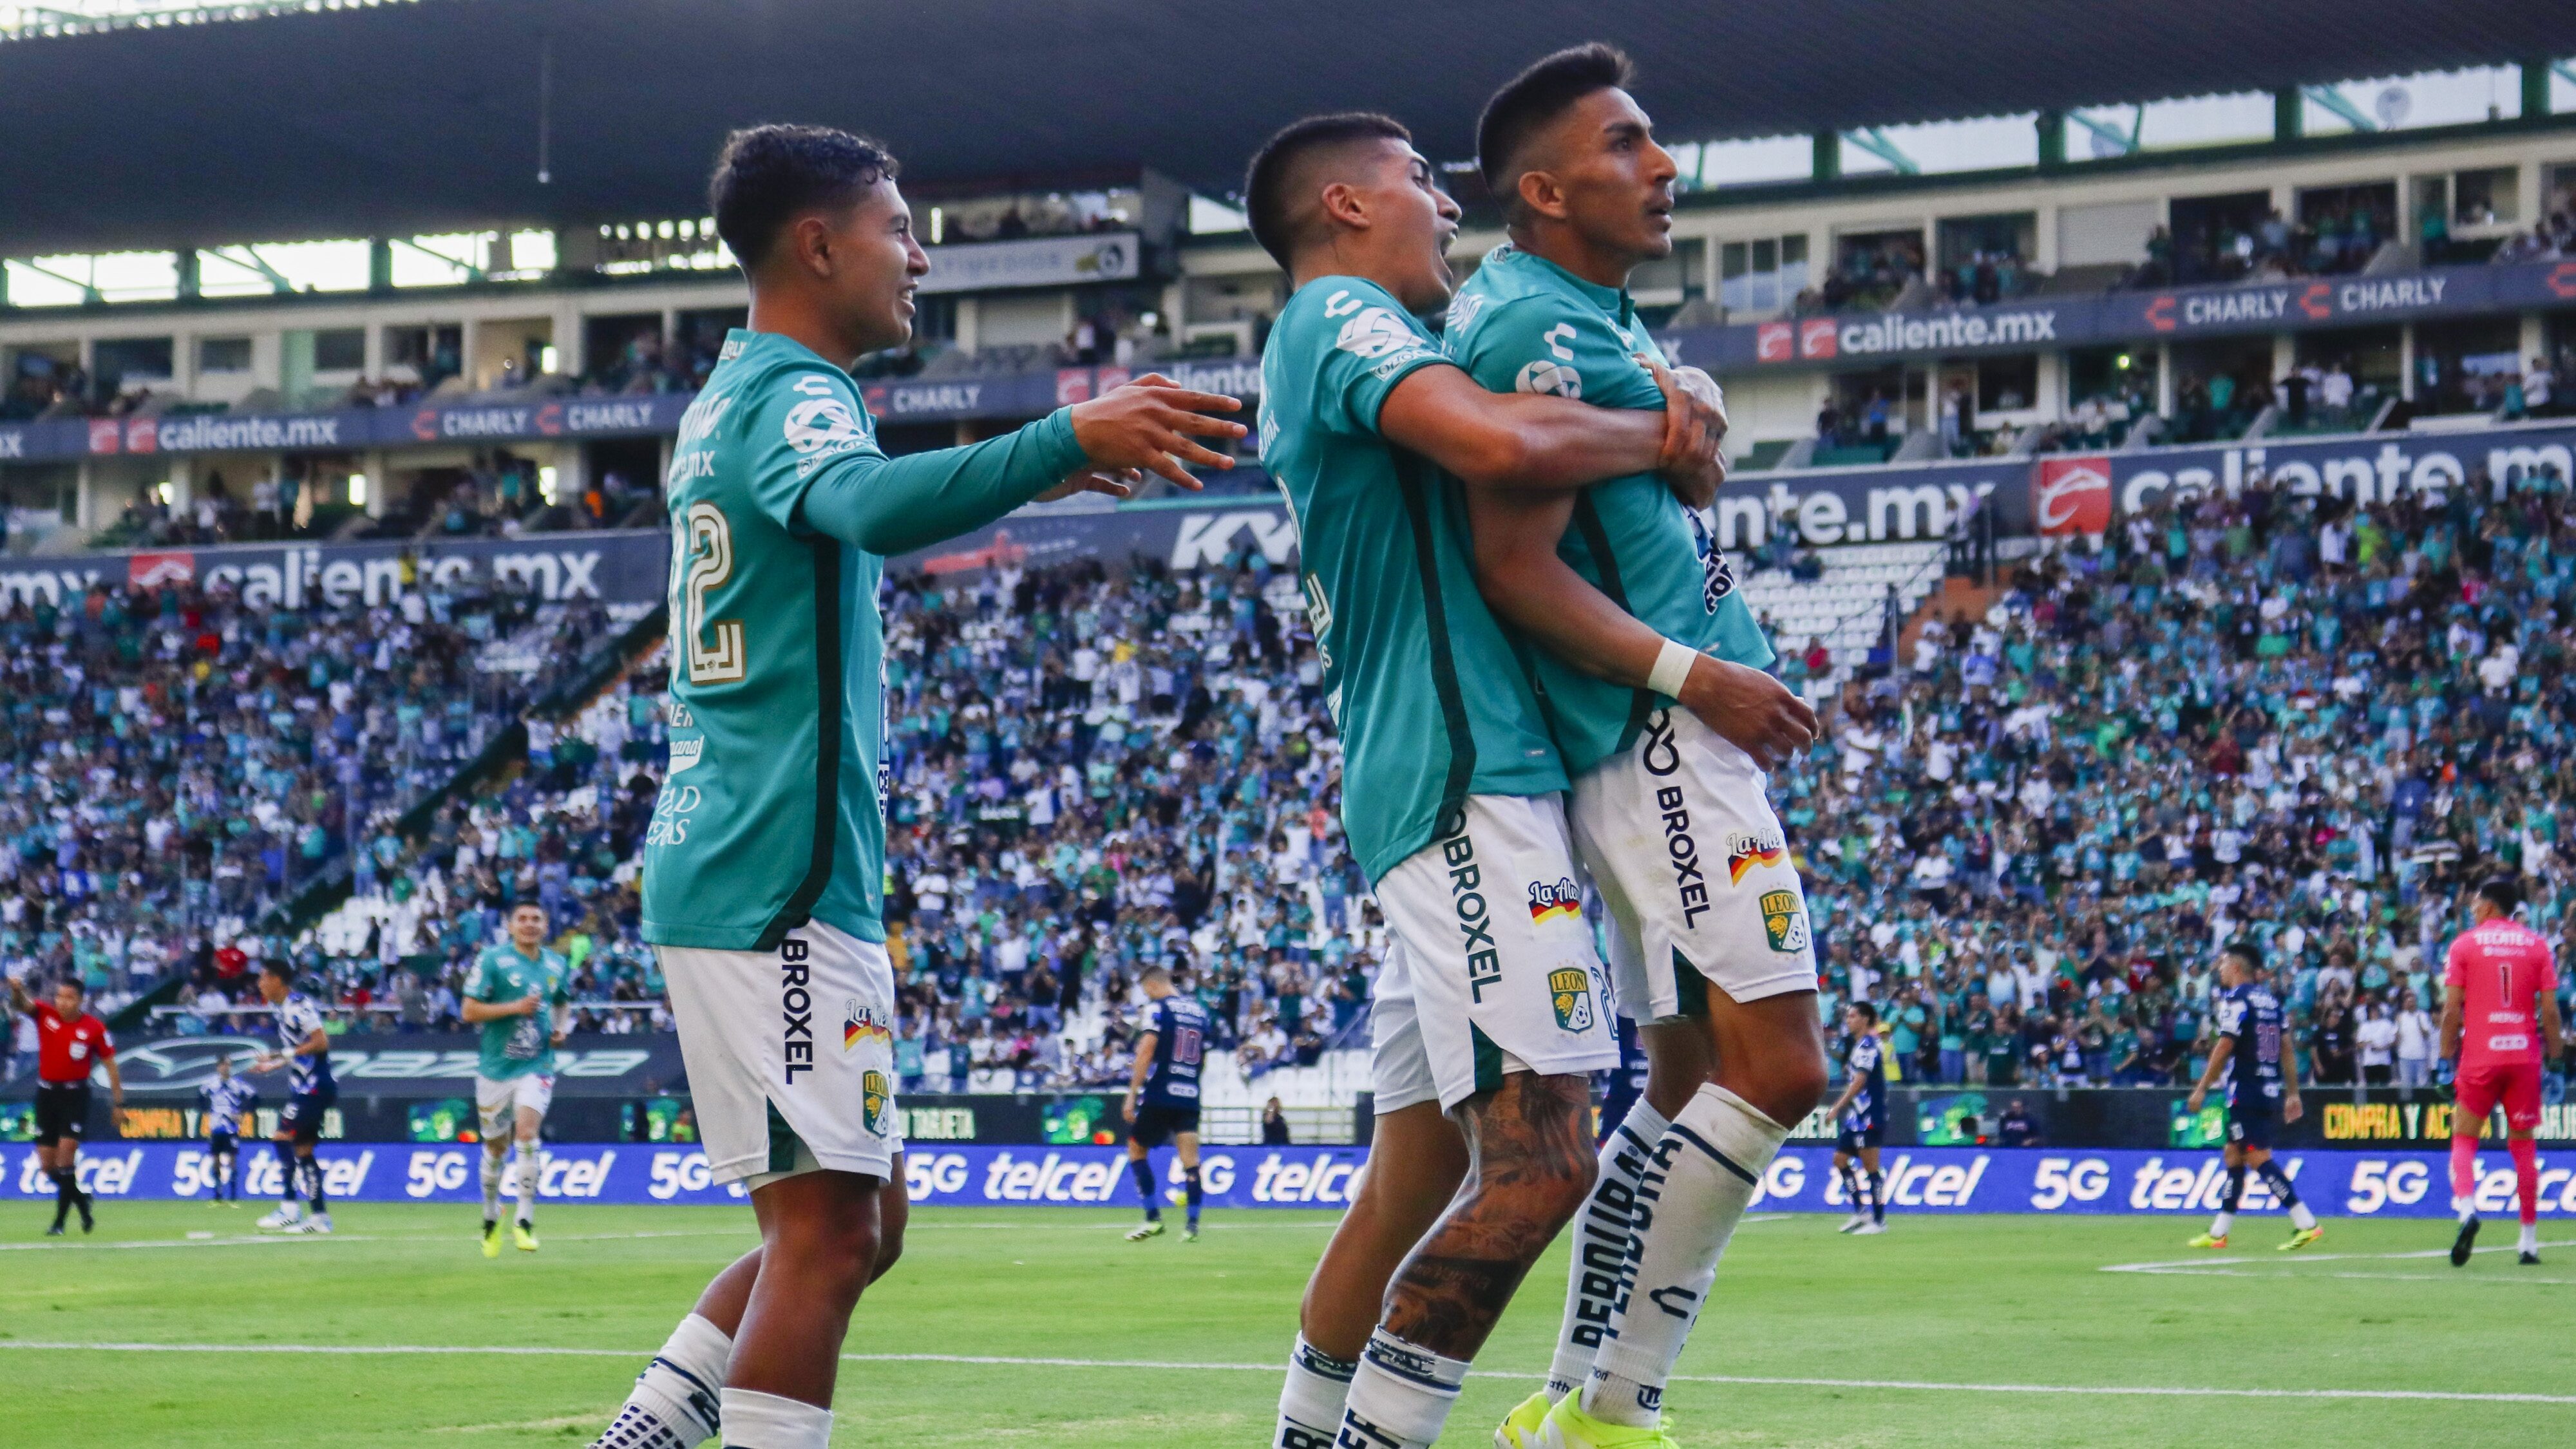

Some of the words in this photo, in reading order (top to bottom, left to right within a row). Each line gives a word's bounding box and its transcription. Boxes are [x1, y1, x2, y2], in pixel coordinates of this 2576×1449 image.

[2184, 290, 2289, 325] CHARLY
[2341, 278, 2447, 312] CHARLY
[1840, 310, 2056, 354] caliente.mx
[568, 404, 654, 430] CHARLY
[893, 386, 981, 414] CHARLY
[158, 416, 337, 450] caliente.mx
[443, 410, 527, 437] CHARLY
[1656, 786, 1711, 929] BROXEL
[1726, 833, 1752, 860] La
[1528, 880, 1553, 908] La
[1443, 835, 1502, 1004] BROXEL
[1553, 972, 1586, 992] LEON
[2499, 962, 2512, 1009] 1
[781, 939, 813, 1085] BROXEL
[1173, 1025, 1202, 1065] 10
[2323, 1103, 2401, 1140] COMPRA
[2403, 1103, 2420, 1140] Y
[19, 1148, 144, 1194] tecel
[245, 1148, 375, 1197] tecel
[405, 1151, 469, 1198] 5G
[649, 1152, 711, 1199] 5G
[905, 1153, 968, 1202] 5G
[983, 1151, 1130, 1202] telcel
[1165, 1153, 1236, 1203] 5G
[1251, 1152, 1367, 1203] telc
[1747, 1156, 1805, 1207] G
[1824, 1154, 1991, 1206] telcel
[2031, 1157, 2110, 1210] 5G
[2129, 1157, 2304, 1213] telcel
[2346, 1160, 2430, 1214] 5G
